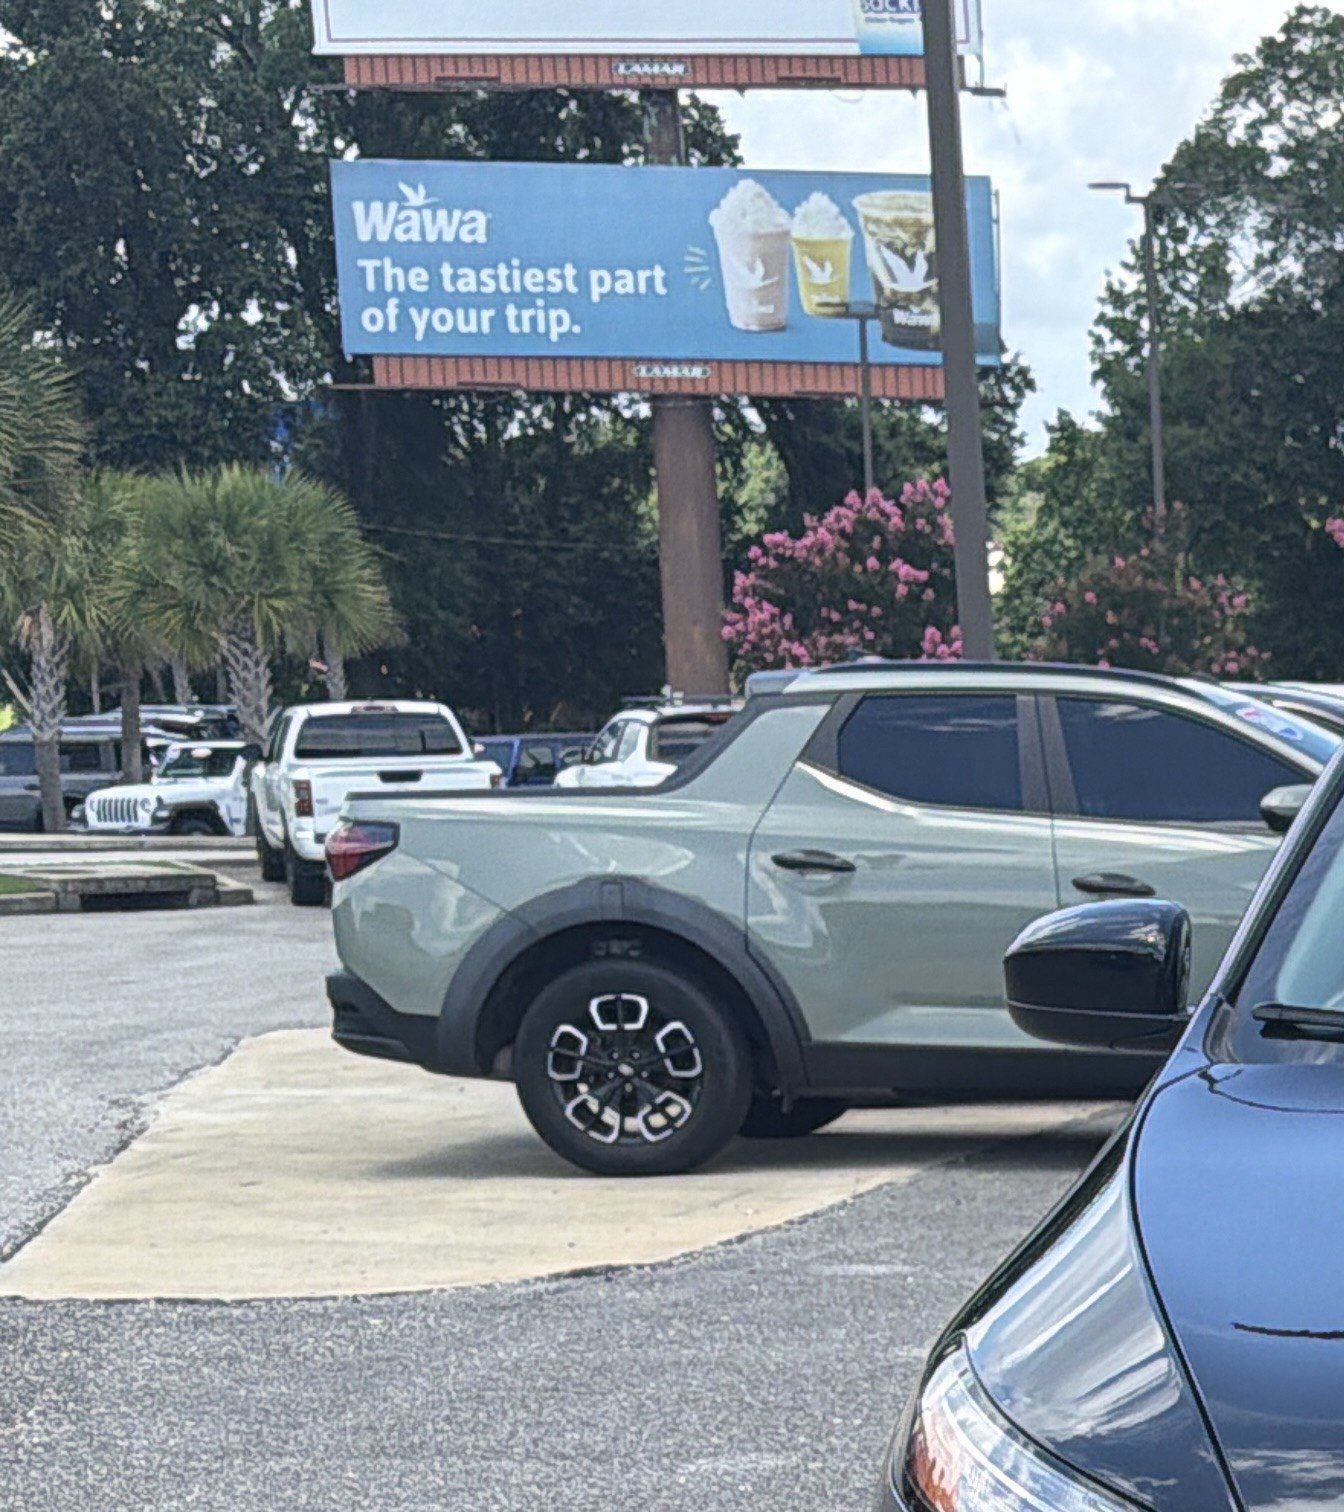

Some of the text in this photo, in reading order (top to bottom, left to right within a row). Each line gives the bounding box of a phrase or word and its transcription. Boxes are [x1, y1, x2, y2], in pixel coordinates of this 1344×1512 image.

[352, 200, 487, 243] Wawa
[356, 257, 667, 303] The tastiest part
[361, 297, 581, 342] of your trip.
